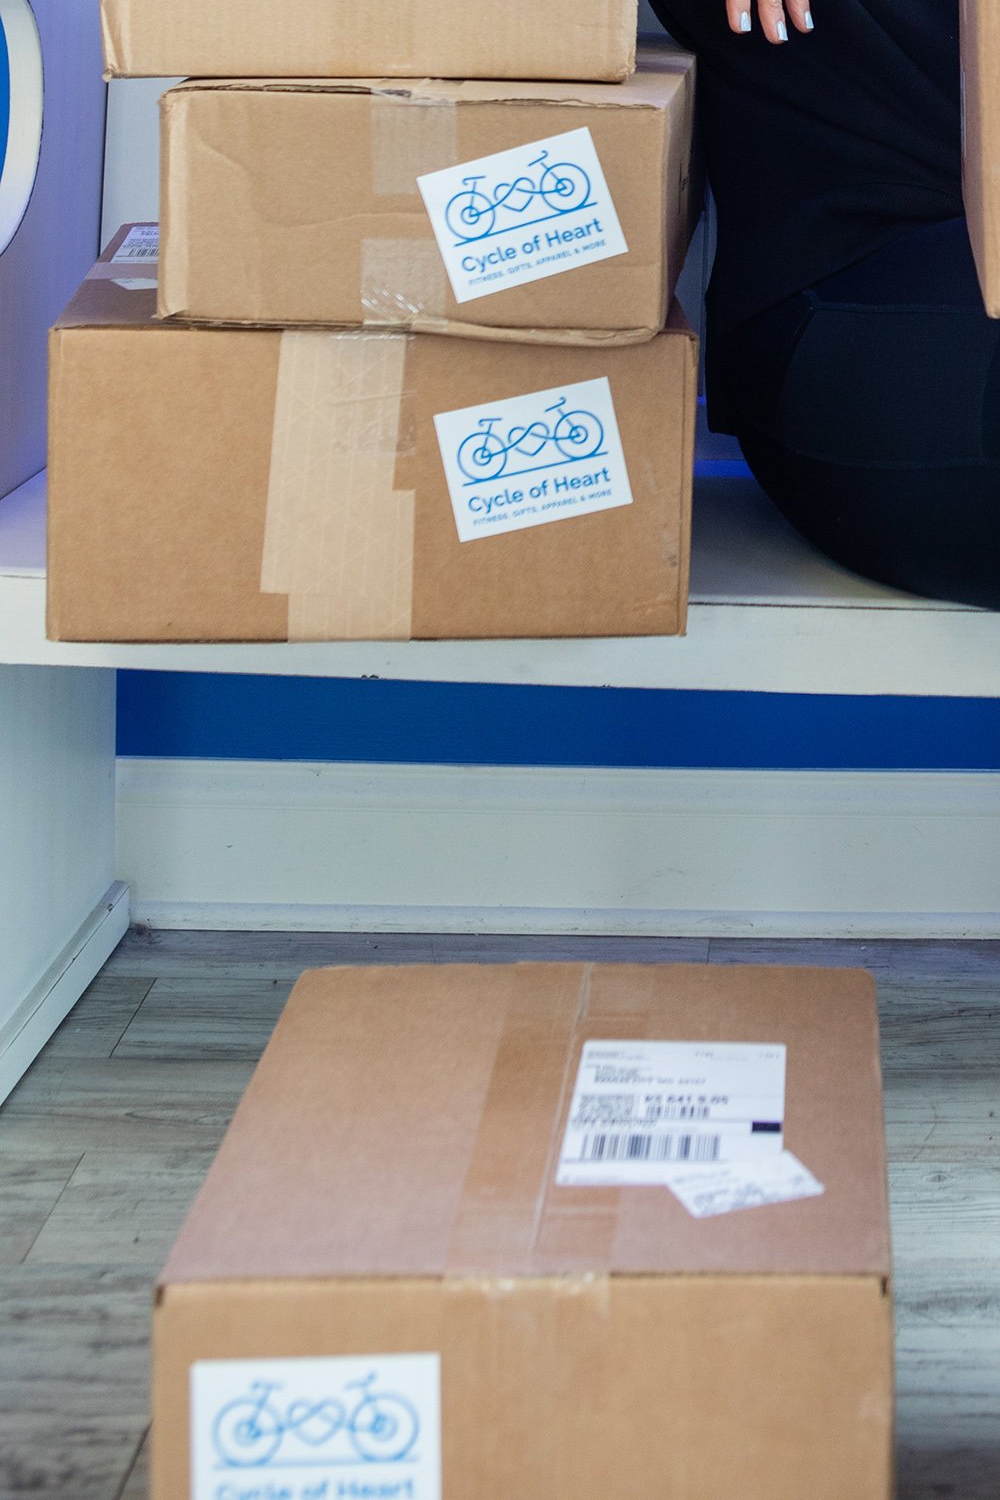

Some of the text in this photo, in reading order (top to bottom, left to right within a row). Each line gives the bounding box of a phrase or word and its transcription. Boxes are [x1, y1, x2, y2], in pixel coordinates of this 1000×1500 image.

[461, 218, 604, 273] Cycle of Heart
[467, 467, 612, 514] Cycle of Heart
